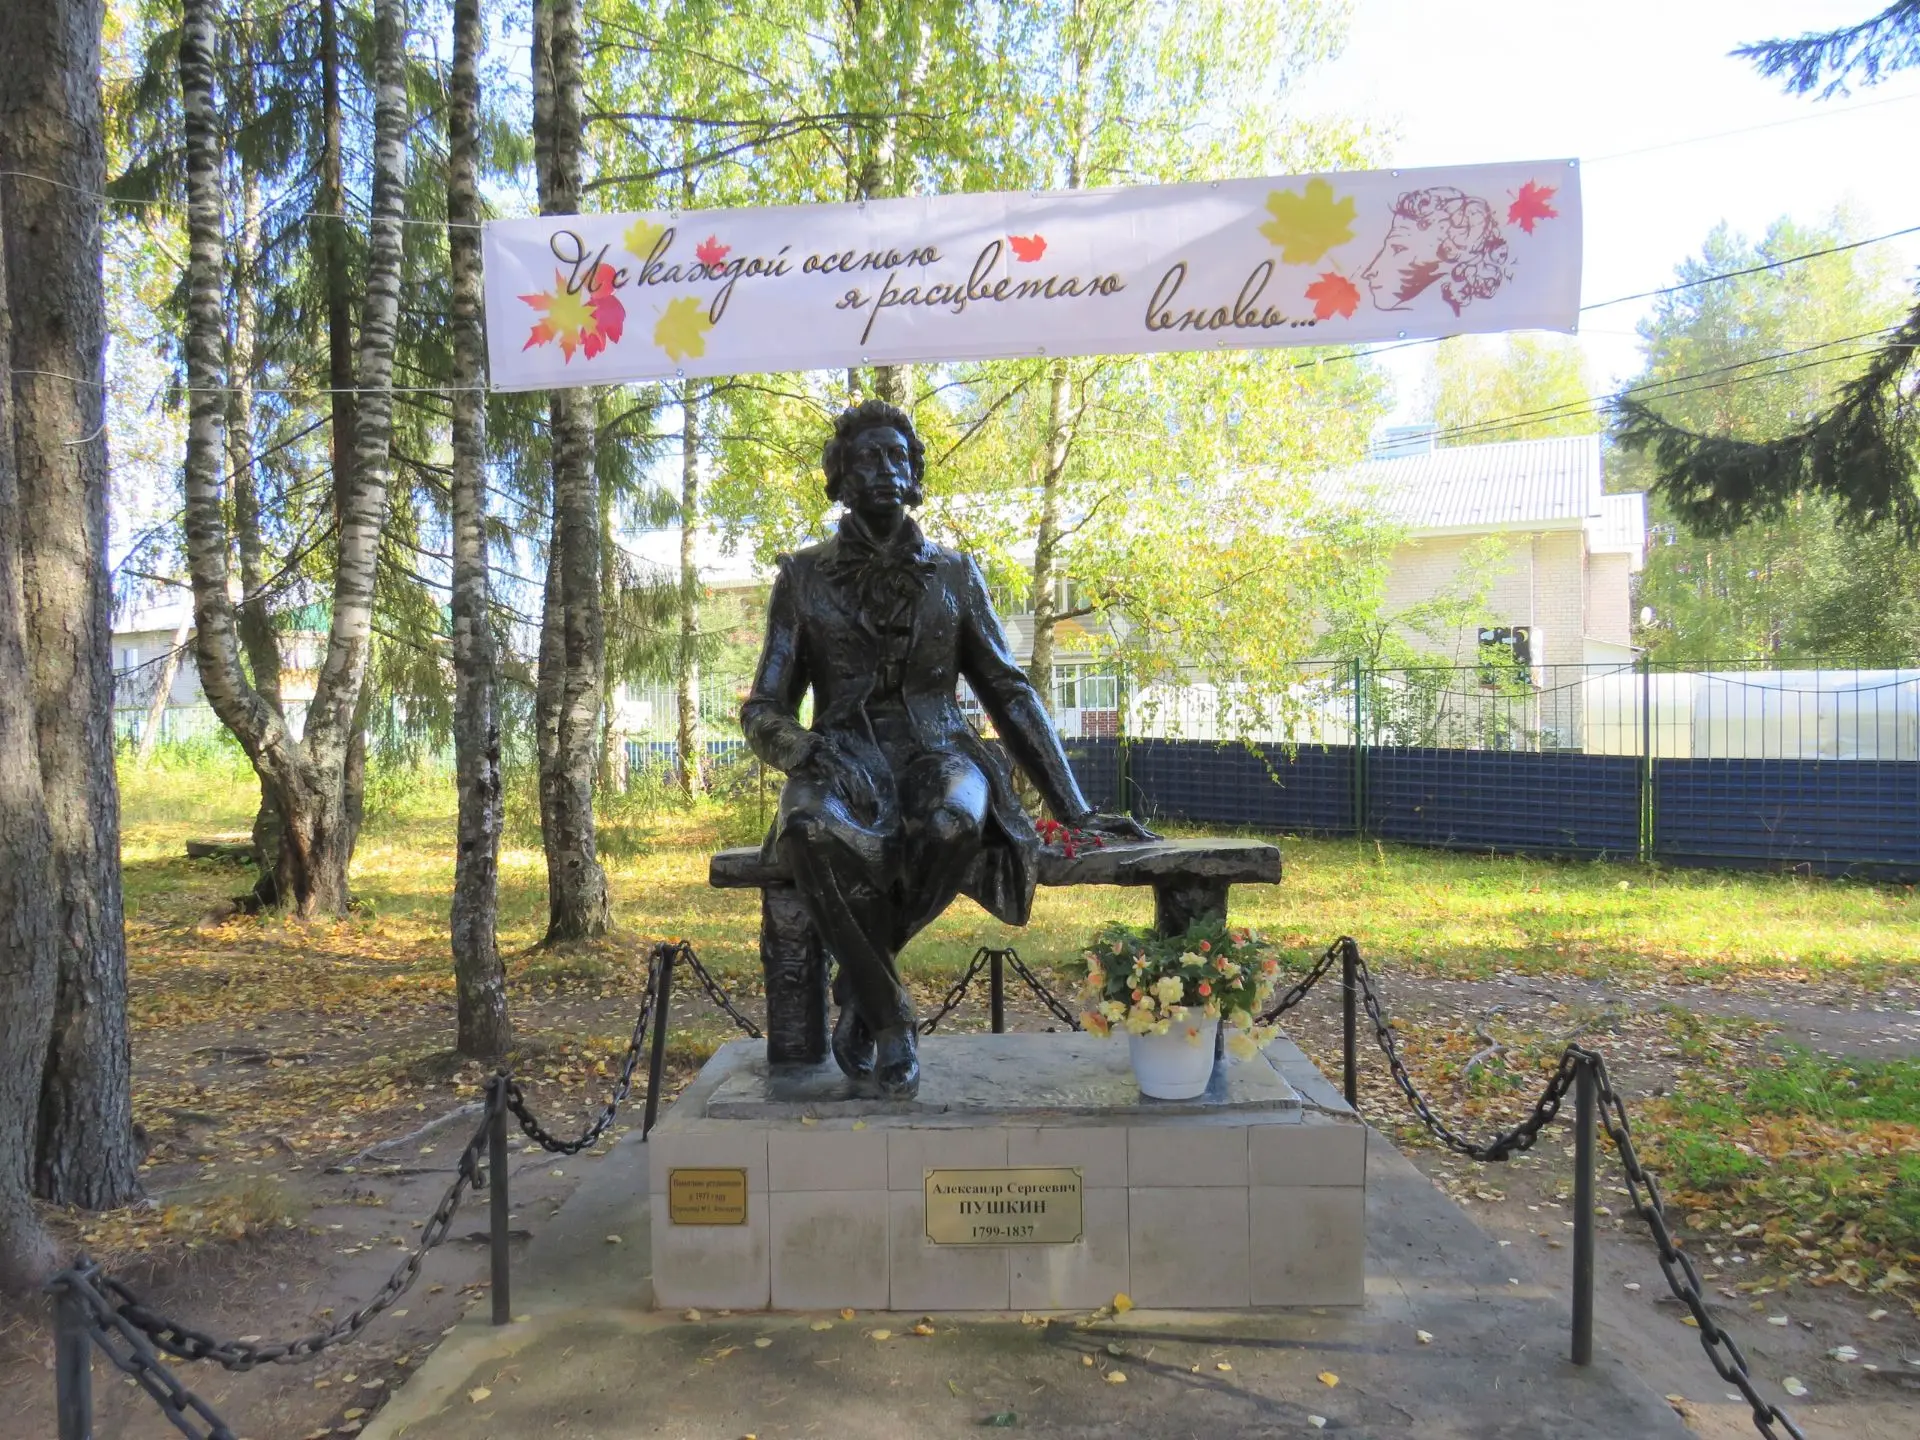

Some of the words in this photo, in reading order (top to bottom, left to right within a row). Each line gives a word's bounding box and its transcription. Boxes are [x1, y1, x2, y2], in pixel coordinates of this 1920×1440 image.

[550, 230, 611, 296] И
[614, 267, 632, 290] с
[637, 227, 793, 325] каждой
[802, 245, 943, 274] осенью
[835, 287, 871, 310] я
[859, 238, 1128, 346] расцветаю
[1145, 259, 1317, 332] вновь...
[932, 1183, 1003, 1197] Александр
[1006, 1182, 1076, 1197] Сергеевич
[959, 1199, 1047, 1215] ПУШКИН
[971, 1225, 1035, 1239] 1799-1837
